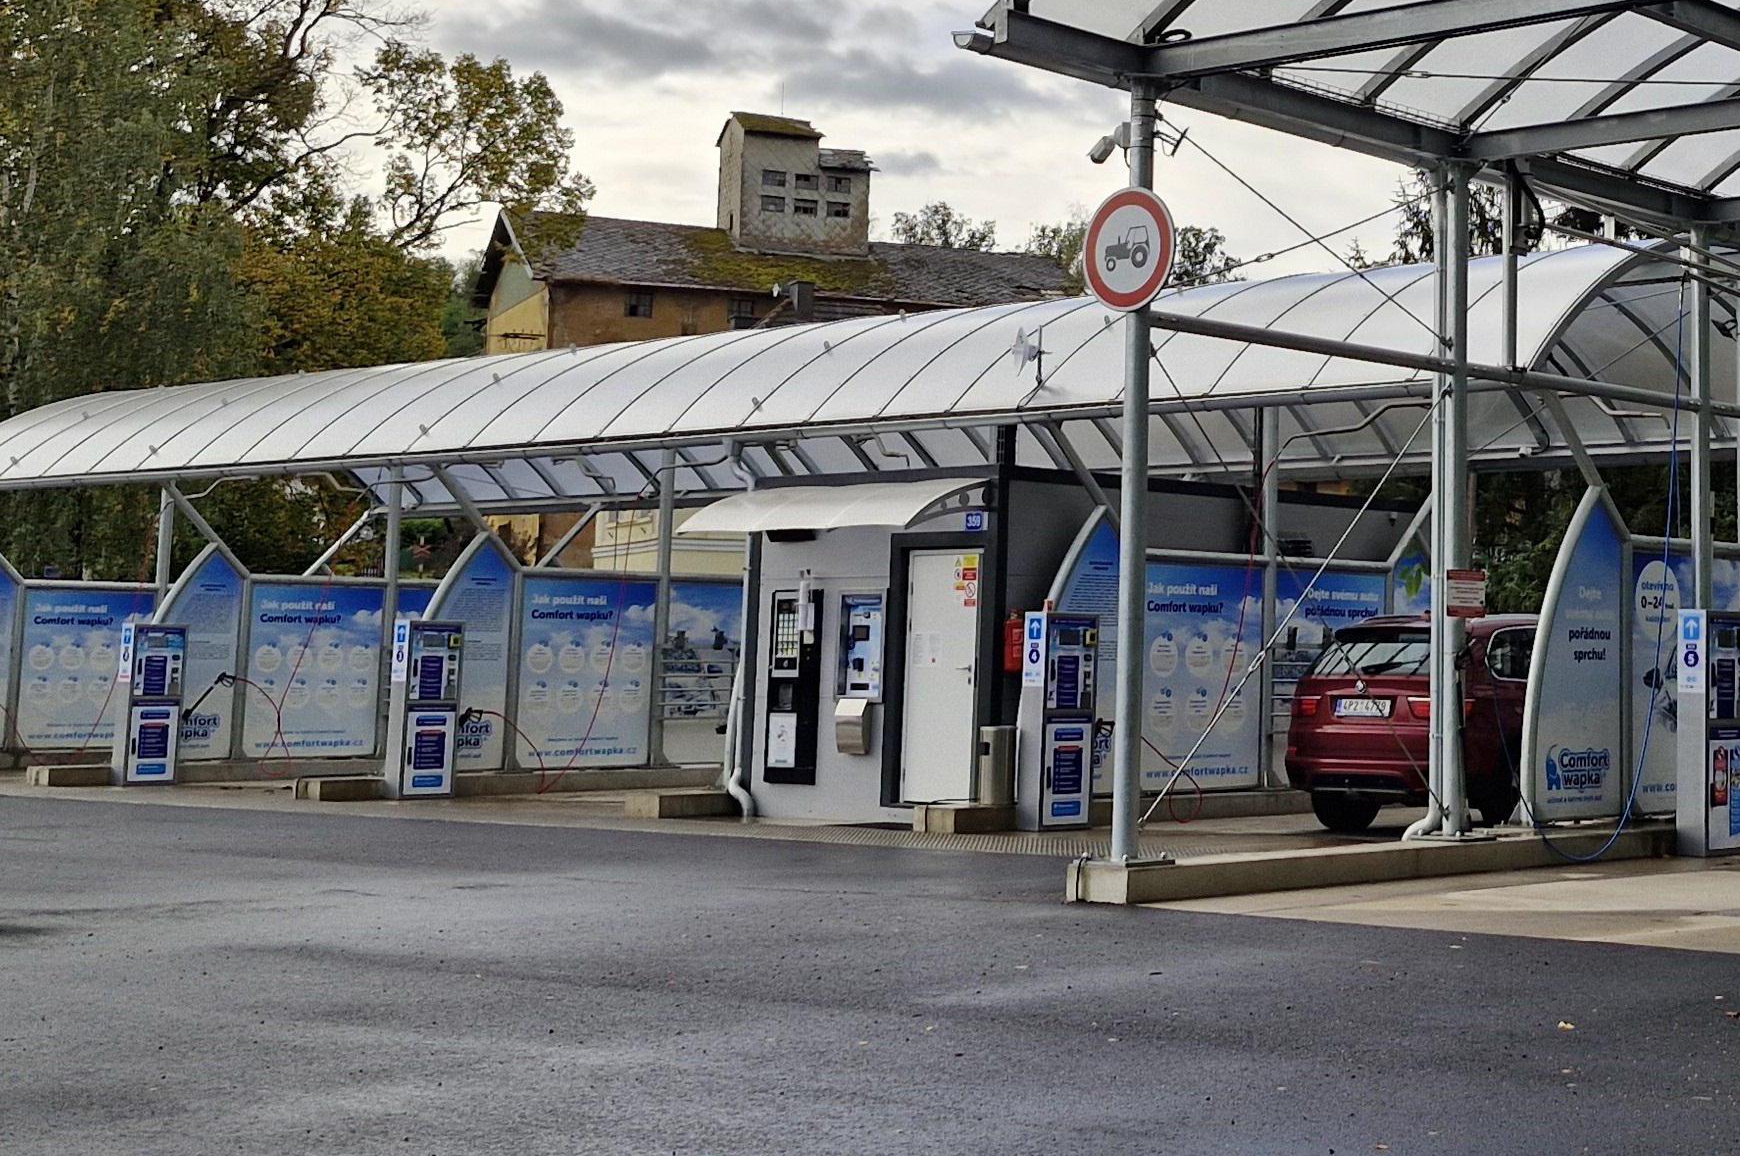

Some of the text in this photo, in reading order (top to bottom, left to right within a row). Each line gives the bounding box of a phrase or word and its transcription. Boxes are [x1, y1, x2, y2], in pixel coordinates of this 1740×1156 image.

[532, 609, 614, 622] Comfort wapku?
[1147, 600, 1224, 616] Comfort wapku?
[1348, 607, 1379, 620] sprchu!
[34, 616, 114, 627] Comfort wapku?
[260, 613, 342, 625] Comfort wapku?
[1569, 627, 1611, 642] pořádnou
[1574, 648, 1606, 663] sprchu!
[1560, 751, 1608, 769] Comfort
[1563, 771, 1601, 790] wapka
